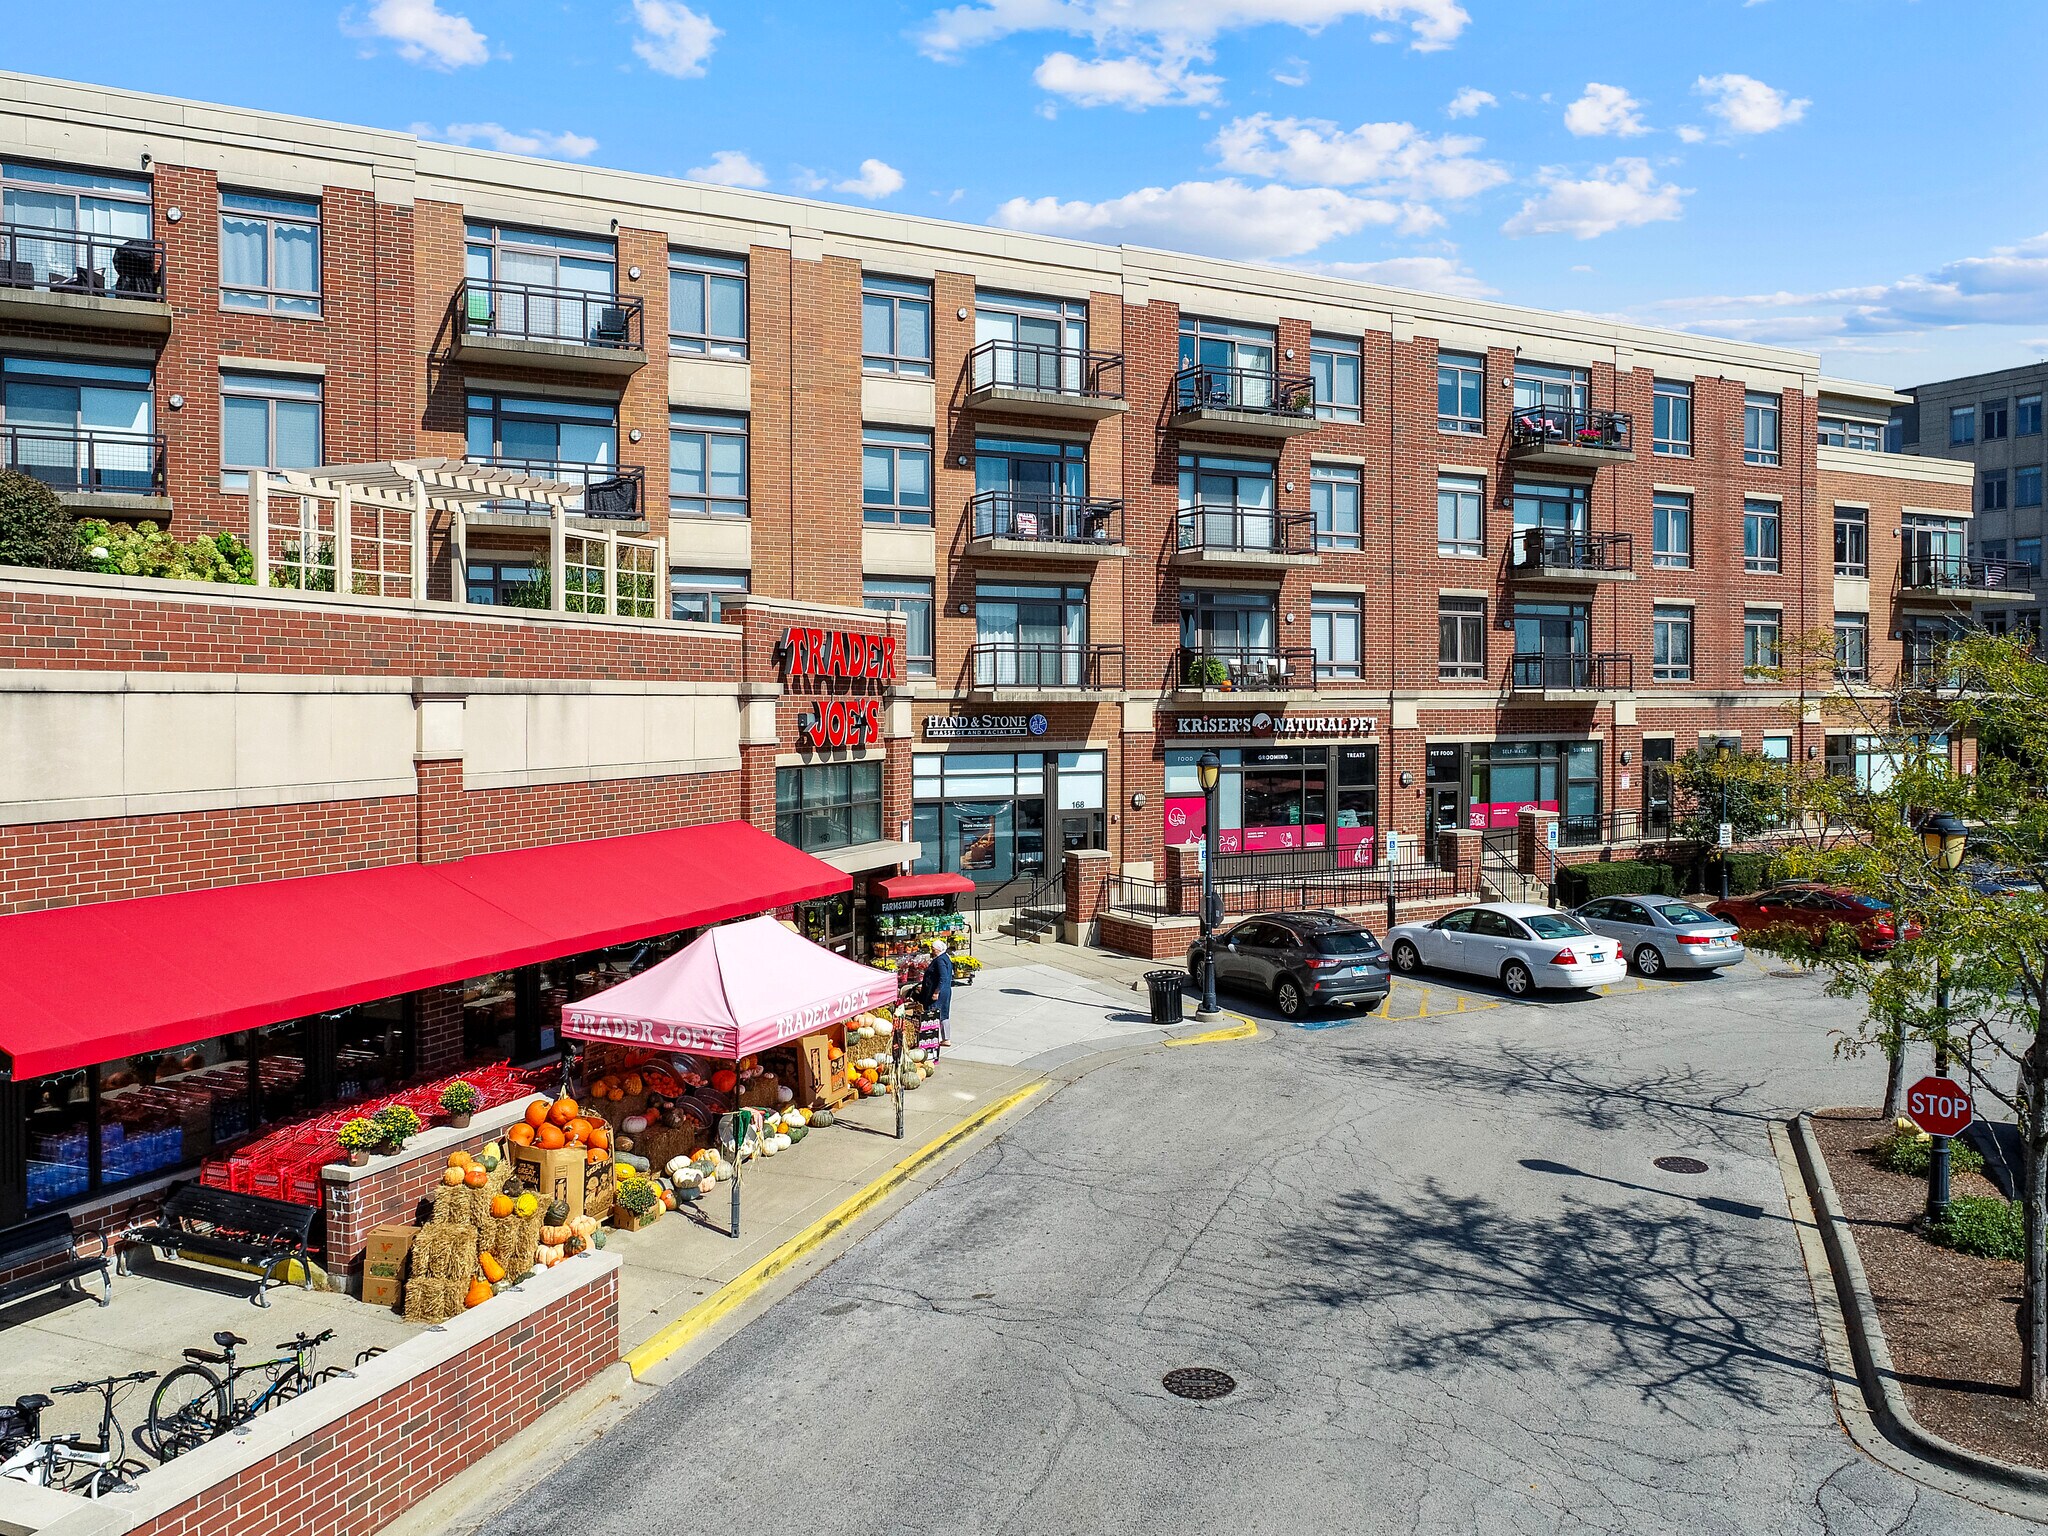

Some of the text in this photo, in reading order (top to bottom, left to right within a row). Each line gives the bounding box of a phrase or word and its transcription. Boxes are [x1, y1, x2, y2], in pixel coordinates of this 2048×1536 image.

[784, 628, 897, 679] TRADER
[808, 698, 880, 747] JOE'S
[927, 714, 1027, 729] HAND & STONE
[1273, 716, 1348, 733] NATURAL
[1348, 716, 1378, 732] PET
[1071, 801, 1085, 809] 168
[881, 898, 945, 912] FARMSTAND FLOWERS
[776, 987, 871, 1039] TRADER JOE'S
[569, 1013, 727, 1051] TRADER JOE'S
[1911, 1092, 1968, 1119] STOP
